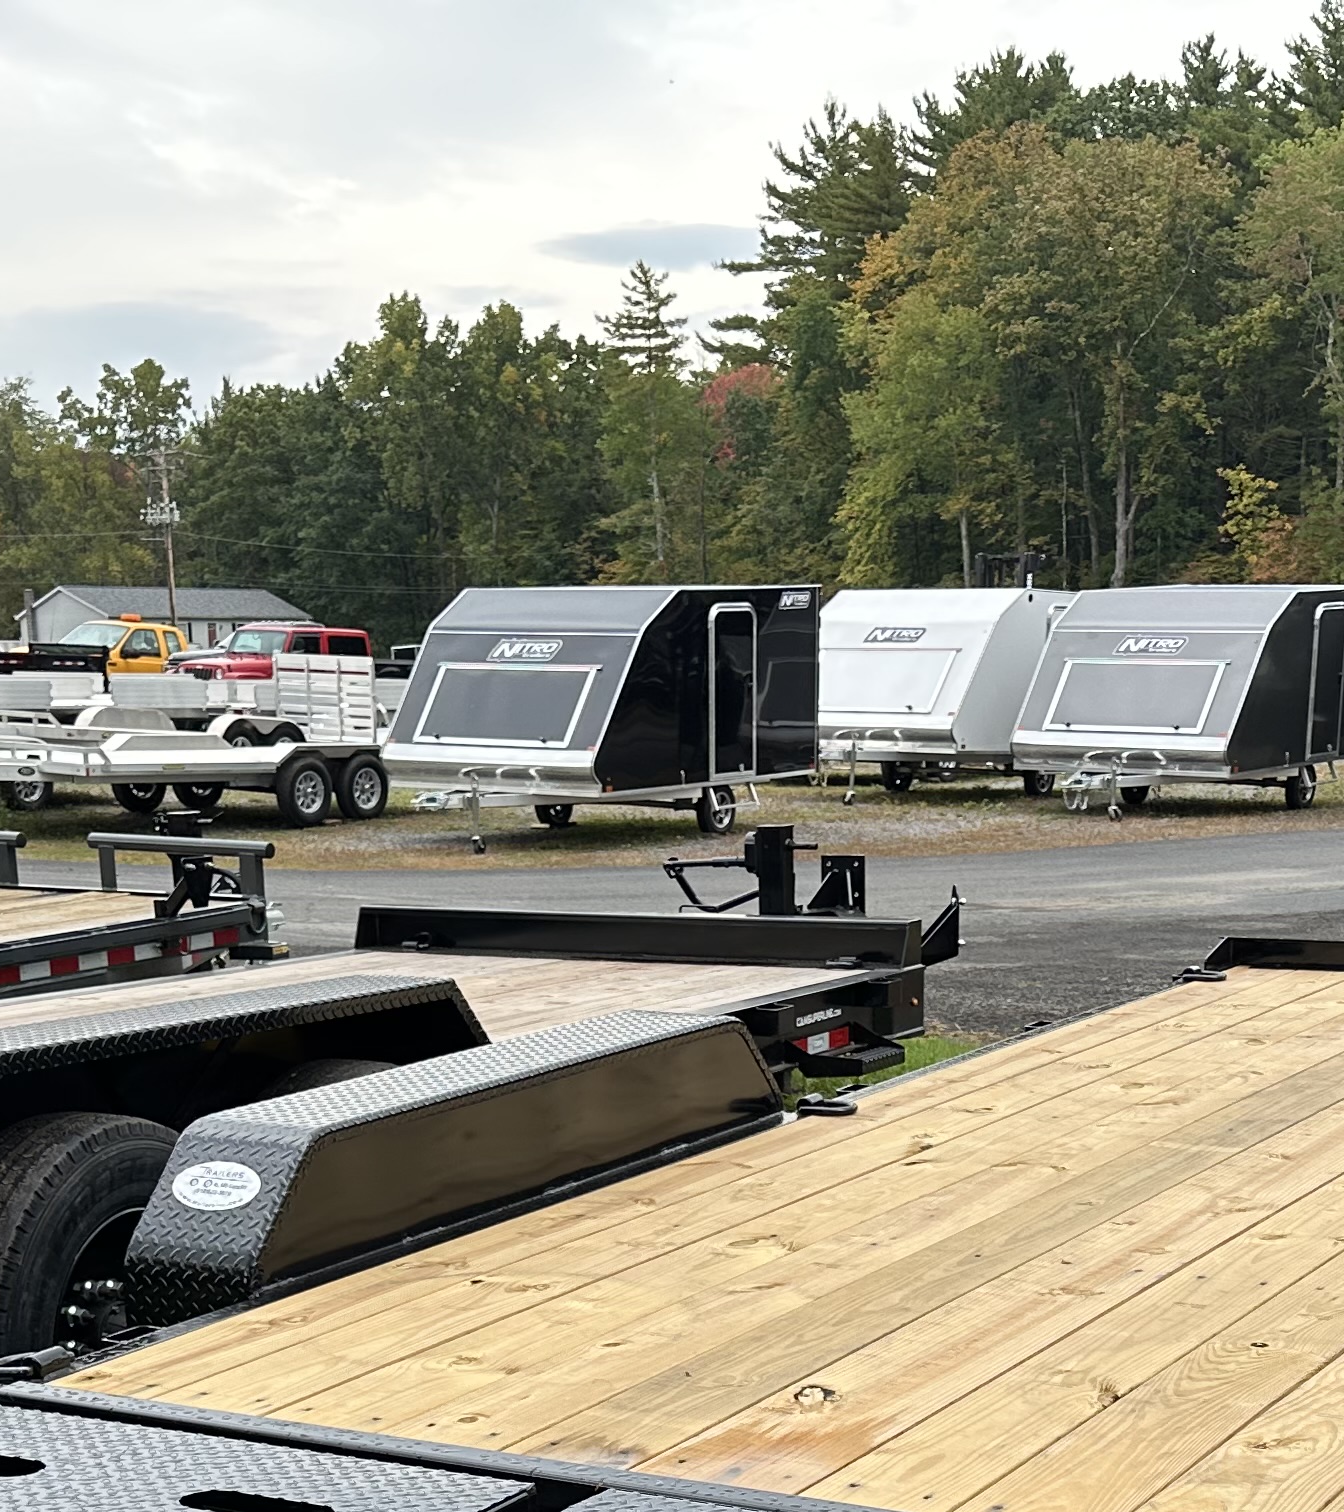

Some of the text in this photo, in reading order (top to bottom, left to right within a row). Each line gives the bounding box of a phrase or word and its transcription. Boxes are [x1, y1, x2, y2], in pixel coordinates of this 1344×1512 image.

[867, 629, 923, 641] NITRO
[493, 642, 558, 657] NITRO
[1118, 638, 1185, 652] NITRO
[200, 1166, 245, 1179] TRAILERS
